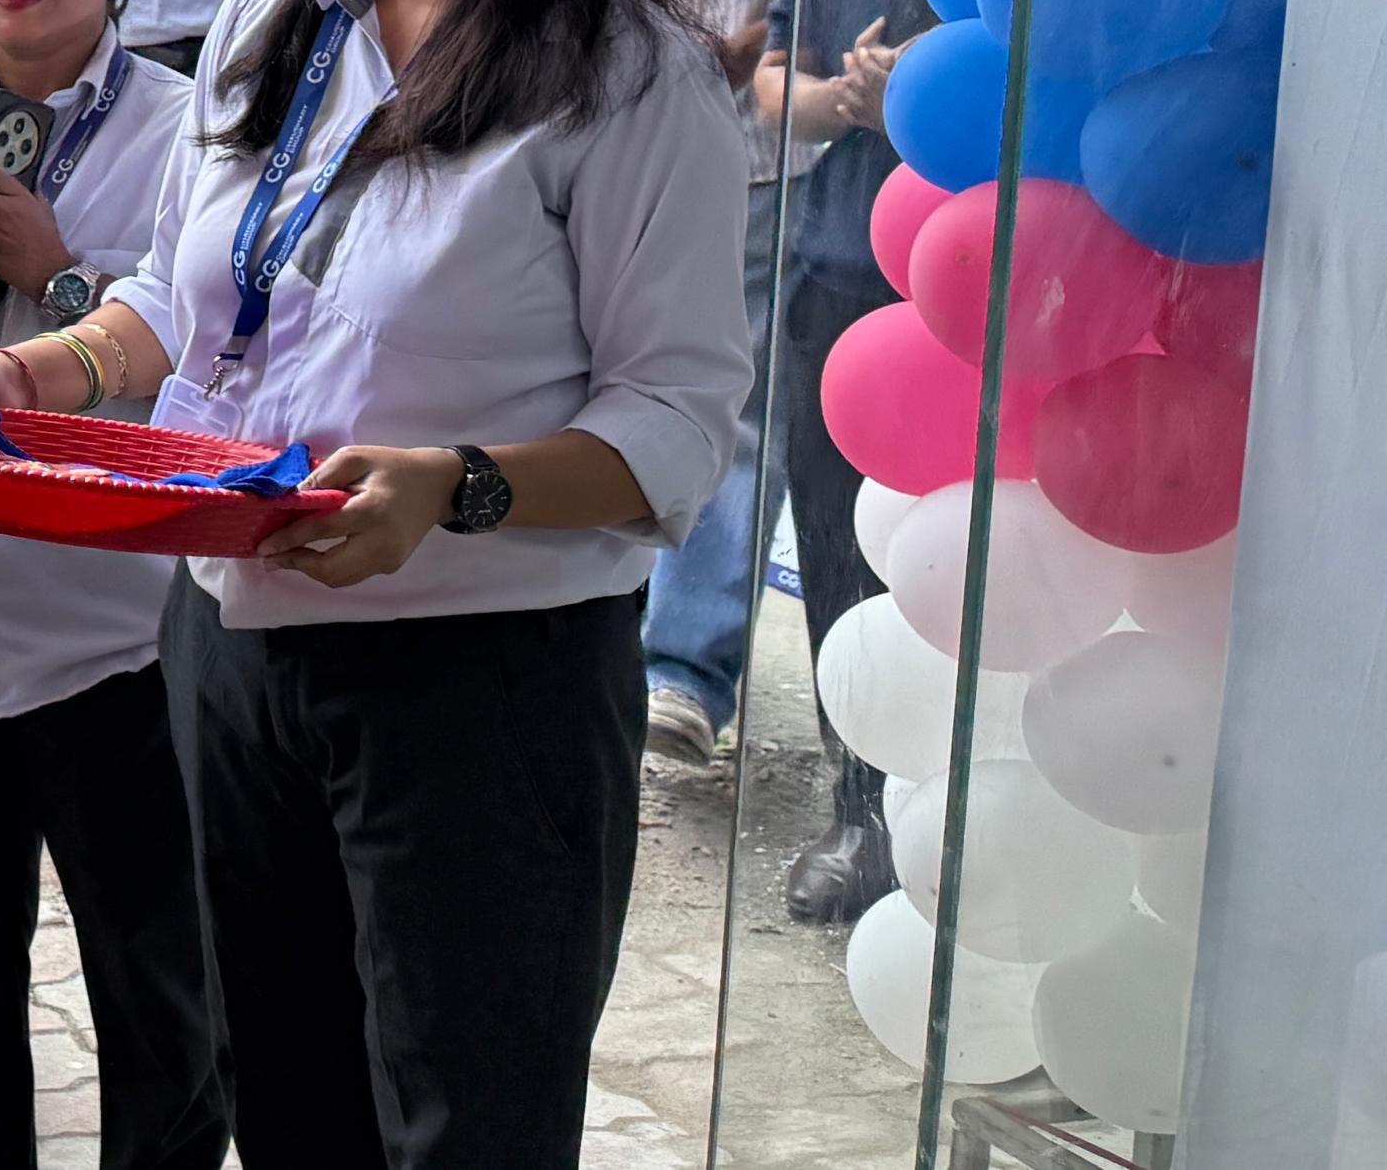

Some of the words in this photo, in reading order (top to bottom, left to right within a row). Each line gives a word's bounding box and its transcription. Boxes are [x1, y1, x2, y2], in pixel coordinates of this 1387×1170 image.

[306, 51, 331, 84] CG
[95, 87, 116, 112] CG
[52, 158, 74, 184] CG
[265, 152, 290, 183] CG
[312, 162, 337, 193] CG
[233, 250, 246, 285] CG
[255, 259, 280, 293] CG
